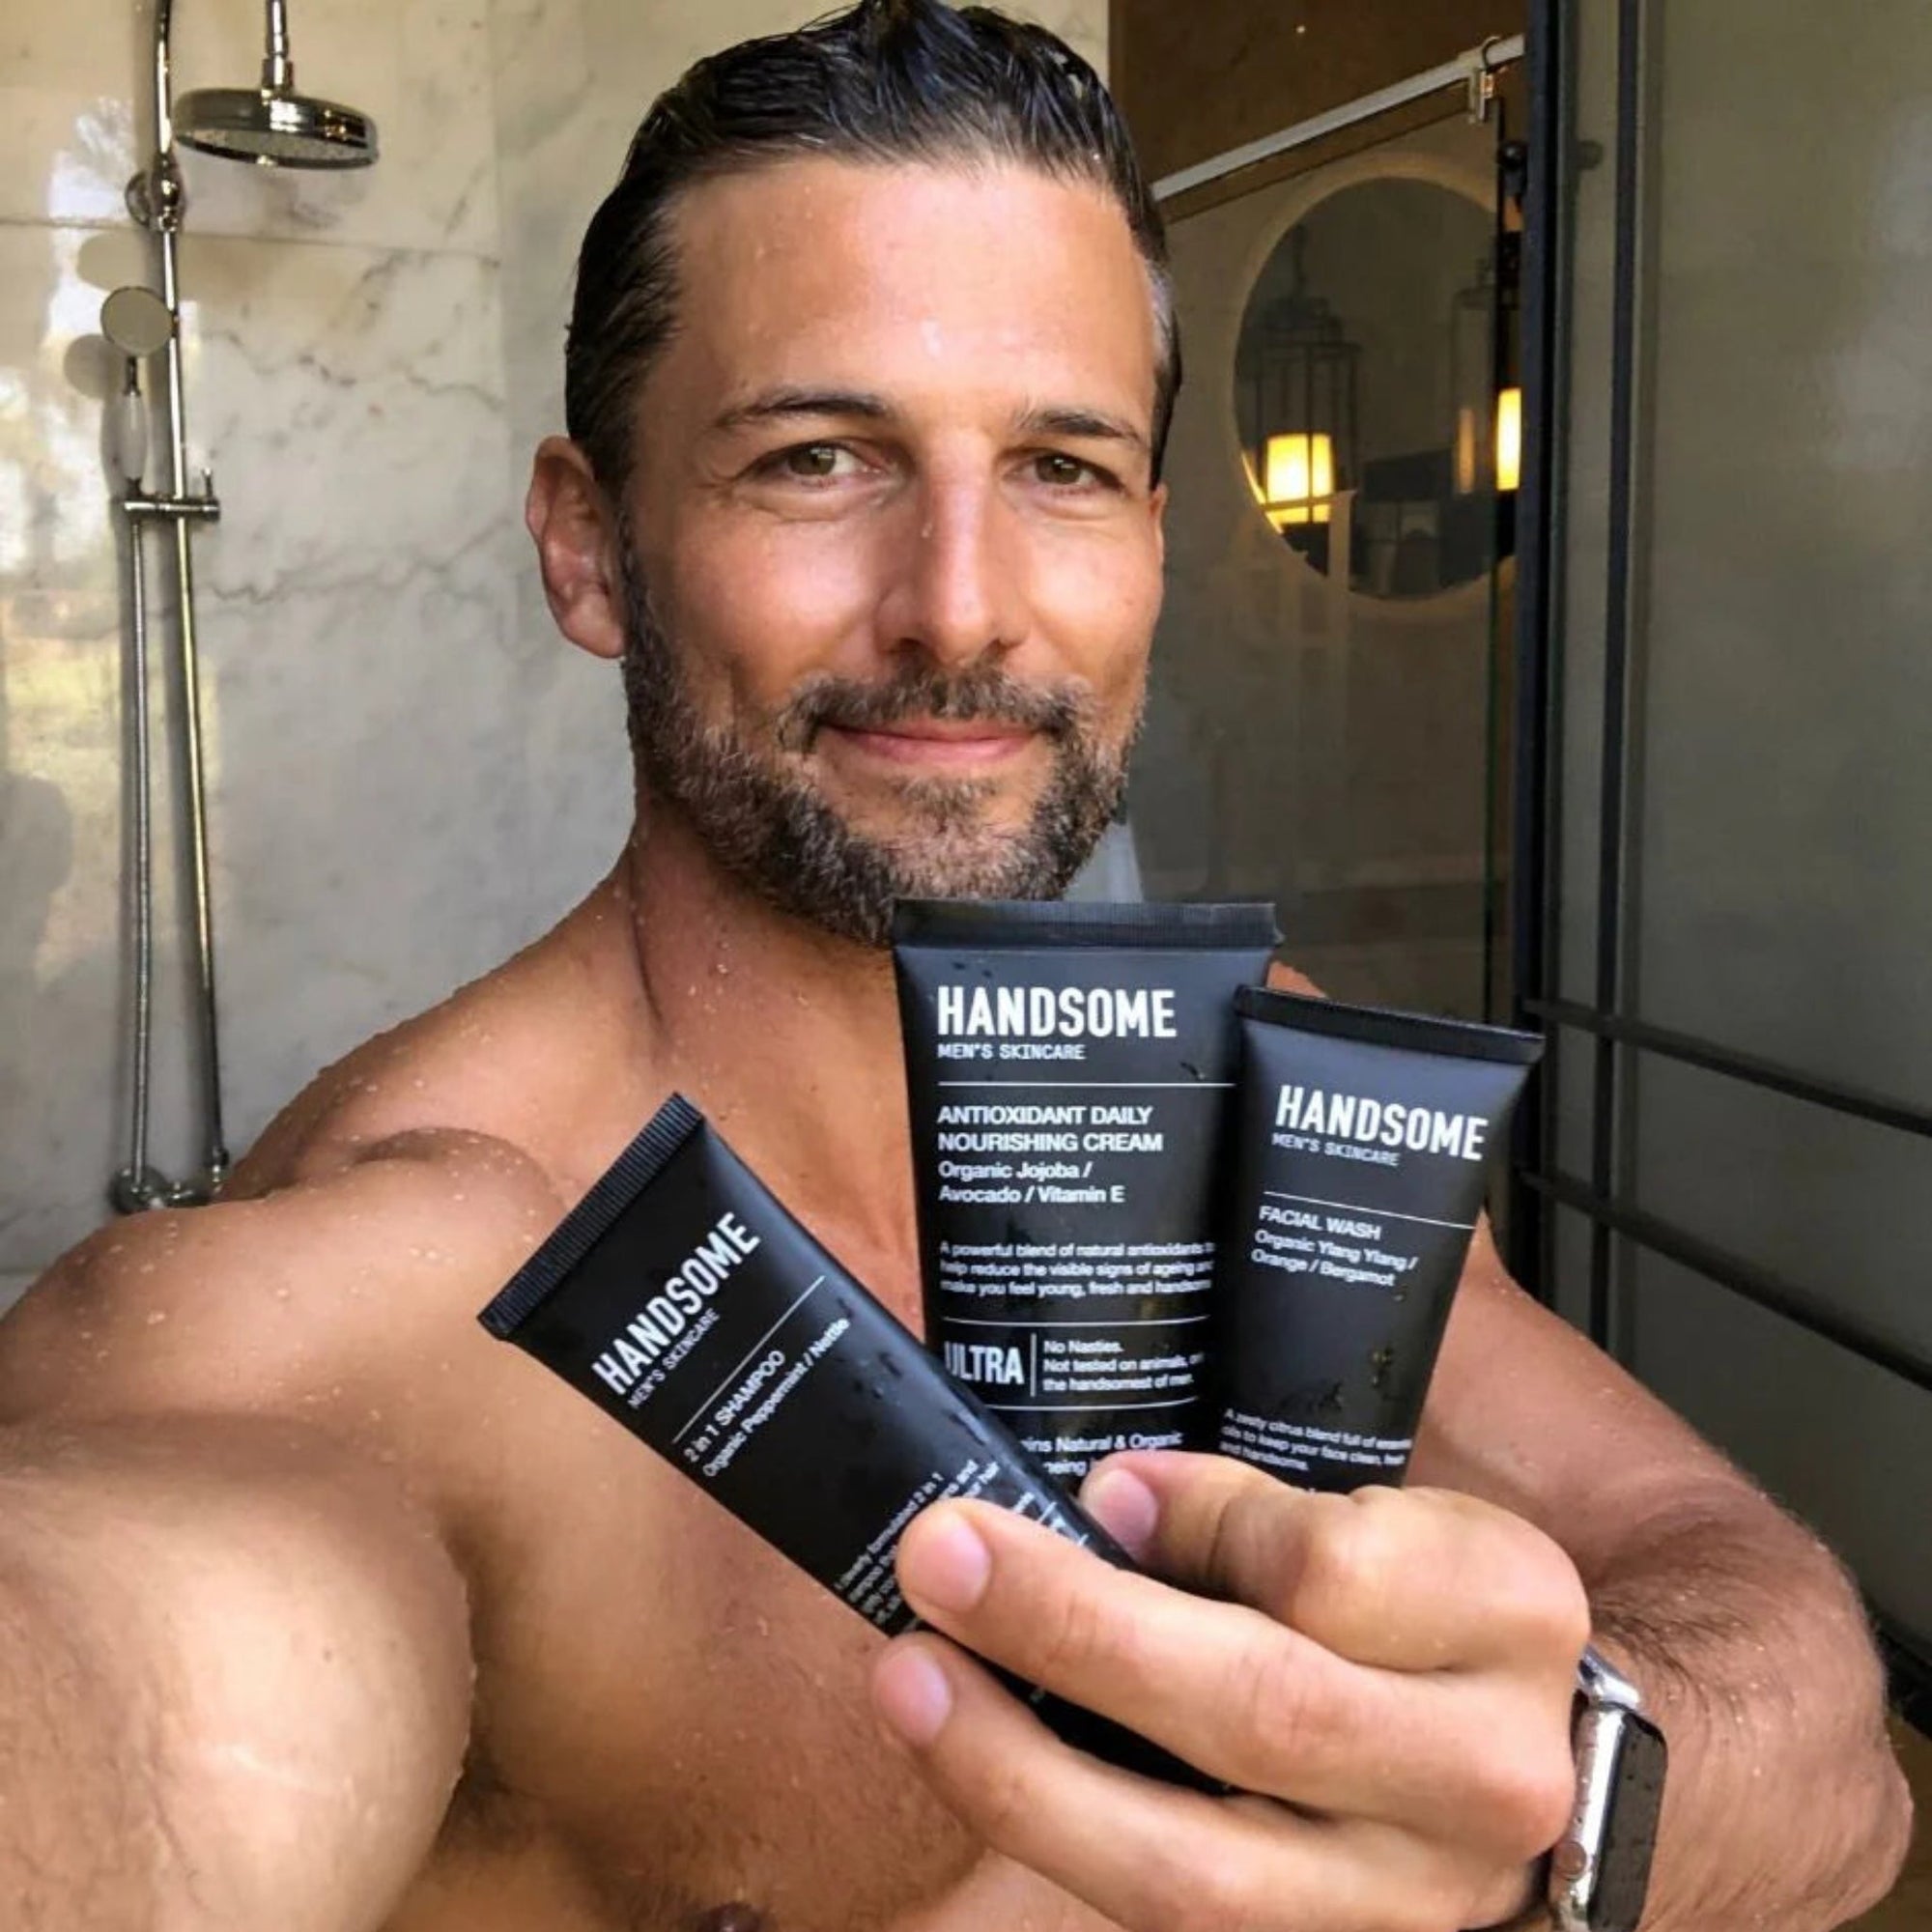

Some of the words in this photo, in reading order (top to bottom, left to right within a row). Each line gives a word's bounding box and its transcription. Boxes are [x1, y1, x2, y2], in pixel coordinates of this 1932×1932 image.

[937, 985, 1178, 1038] HANDSOME
[937, 1043, 993, 1060] MEN'S
[999, 1044, 1086, 1060] SKINCARE
[937, 1106, 1087, 1124] ANTIOXIDANT
[1090, 1106, 1153, 1124] DAILY
[1275, 1084, 1489, 1161] HANDSOME
[937, 1132, 1078, 1151] NOURISHING
[1082, 1132, 1163, 1151] CREAM
[1271, 1132, 1321, 1153] MEN'S
[1324, 1141, 1400, 1167] SKINCARE
[937, 1160, 1012, 1181] Organic
[1016, 1161, 1080, 1181] Jojoba
[937, 1185, 1022, 1204] Avocado
[1037, 1185, 1107, 1203] Vitamin
[1111, 1186, 1124, 1203] E
[1259, 1206, 1323, 1232] FACIAL
[1326, 1217, 1382, 1241] WASH
[940, 1240, 951, 1255] A
[952, 1243, 1014, 1258] powerful
[1016, 1243, 1056, 1257] blend
[1059, 1243, 1076, 1257] of
[1077, 1243, 1124, 1257] natural
[1255, 1230, 1315, 1253] Organic
[1318, 1240, 1361, 1263] Ylang
[1364, 1248, 1407, 1272] Ylang
[971, 1263, 1020, 1276] reduce
[1024, 1263, 1047, 1276] the
[1050, 1263, 1094, 1277] visible
[1095, 1263, 1133, 1279] signs
[1136, 1263, 1151, 1276] of
[1251, 1248, 1308, 1272] Orange
[1320, 1261, 1397, 1288] Bergamot
[979, 1282, 1007, 1296] you
[1009, 1282, 1036, 1294] feel
[1089, 1281, 1123, 1294] fresh
[1125, 1281, 1152, 1294] and
[591, 1211, 761, 1395] HANDSOME
[1043, 1340, 1065, 1353] No
[628, 1369, 667, 1410] MEN'S
[662, 1307, 721, 1371] SKINCARE
[944, 1341, 1025, 1385] ULTRA
[1043, 1359, 1069, 1373] Not
[1072, 1359, 1117, 1373] tested
[1120, 1360, 1138, 1373] on
[714, 1350, 786, 1427] SHAMPOO
[1043, 1378, 1067, 1392] the
[1154, 1375, 1168, 1389] of
[702, 1431, 748, 1477] Organic
[741, 1361, 806, 1435] Peppermint
[808, 1318, 851, 1360] Nettle
[690, 1435, 712, 1453] in
[1055, 1435, 1112, 1453] Natural
[1115, 1435, 1125, 1451] &
[1304, 1426, 1342, 1443] blend
[684, 1446, 699, 1463] 2
